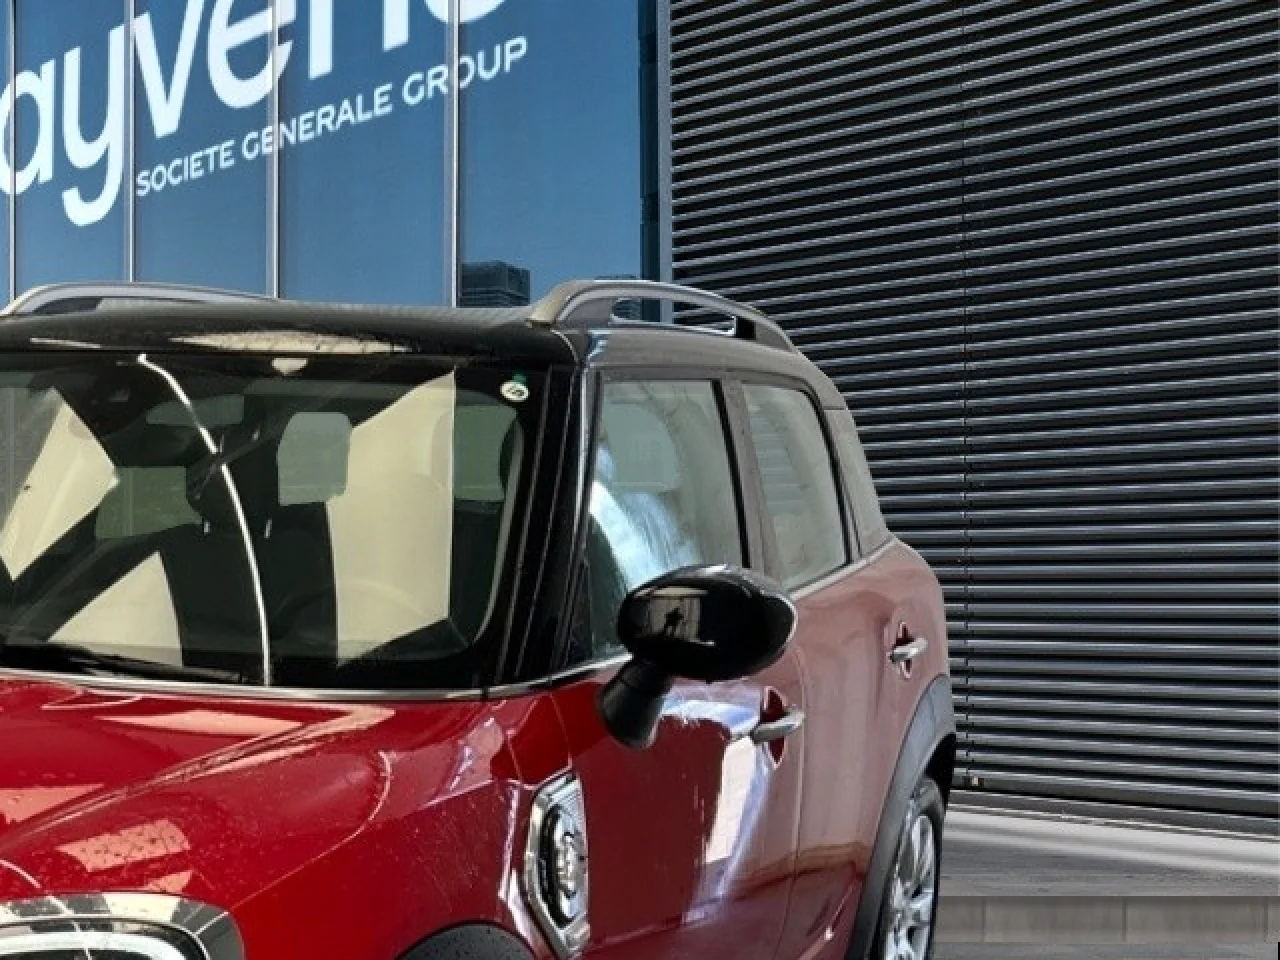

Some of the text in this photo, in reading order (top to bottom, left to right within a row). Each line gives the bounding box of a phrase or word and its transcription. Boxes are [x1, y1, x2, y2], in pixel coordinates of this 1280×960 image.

[136, 36, 528, 197] SOCIETE GENERALE GROUP
